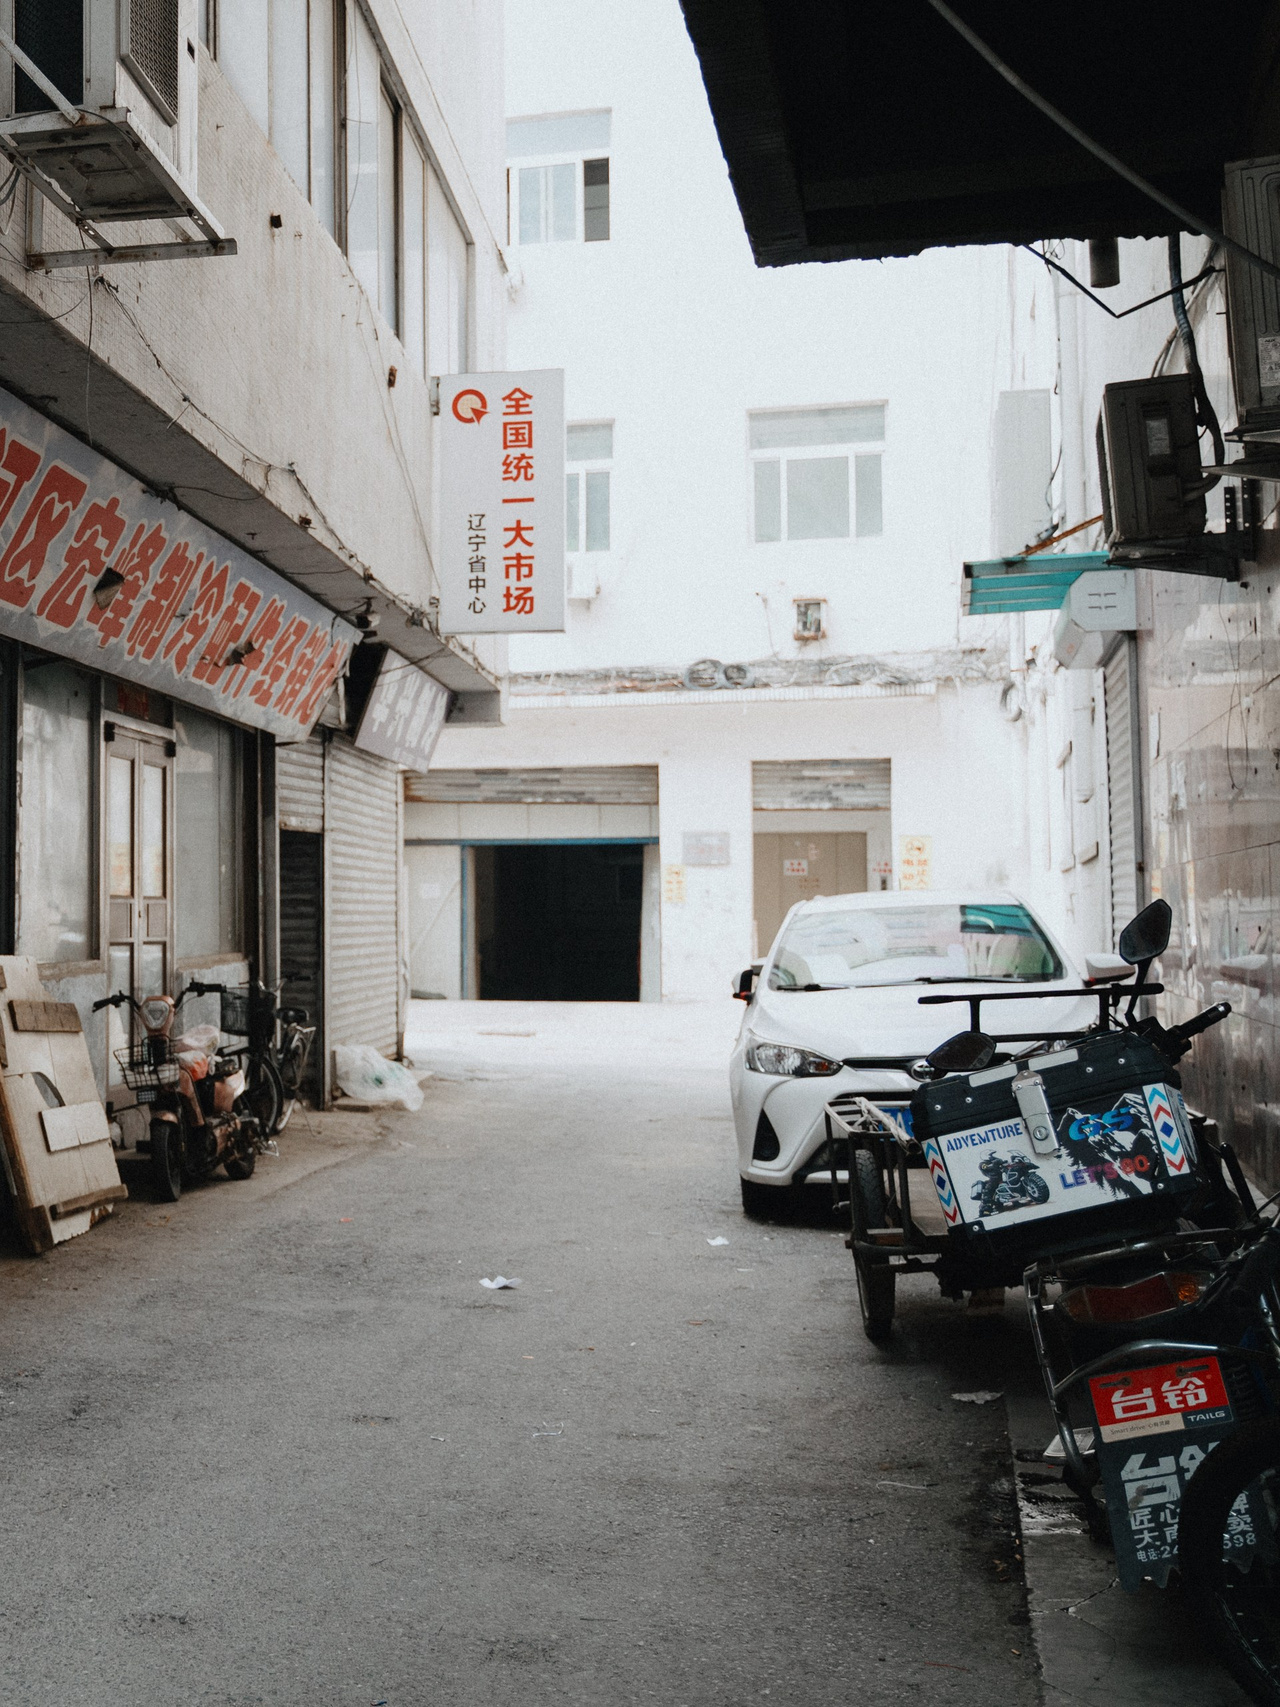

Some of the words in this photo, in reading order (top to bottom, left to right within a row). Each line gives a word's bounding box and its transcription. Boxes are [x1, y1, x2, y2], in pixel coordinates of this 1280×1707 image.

[501, 387, 535, 615] 全国统一大市场
[466, 513, 487, 614] 辽宁省中心
[1068, 1105, 1134, 1141] GS
[1059, 1161, 1120, 1190] LET'S
[1111, 1376, 1208, 1420] 台铃
[1187, 1410, 1226, 1422] TAILG
